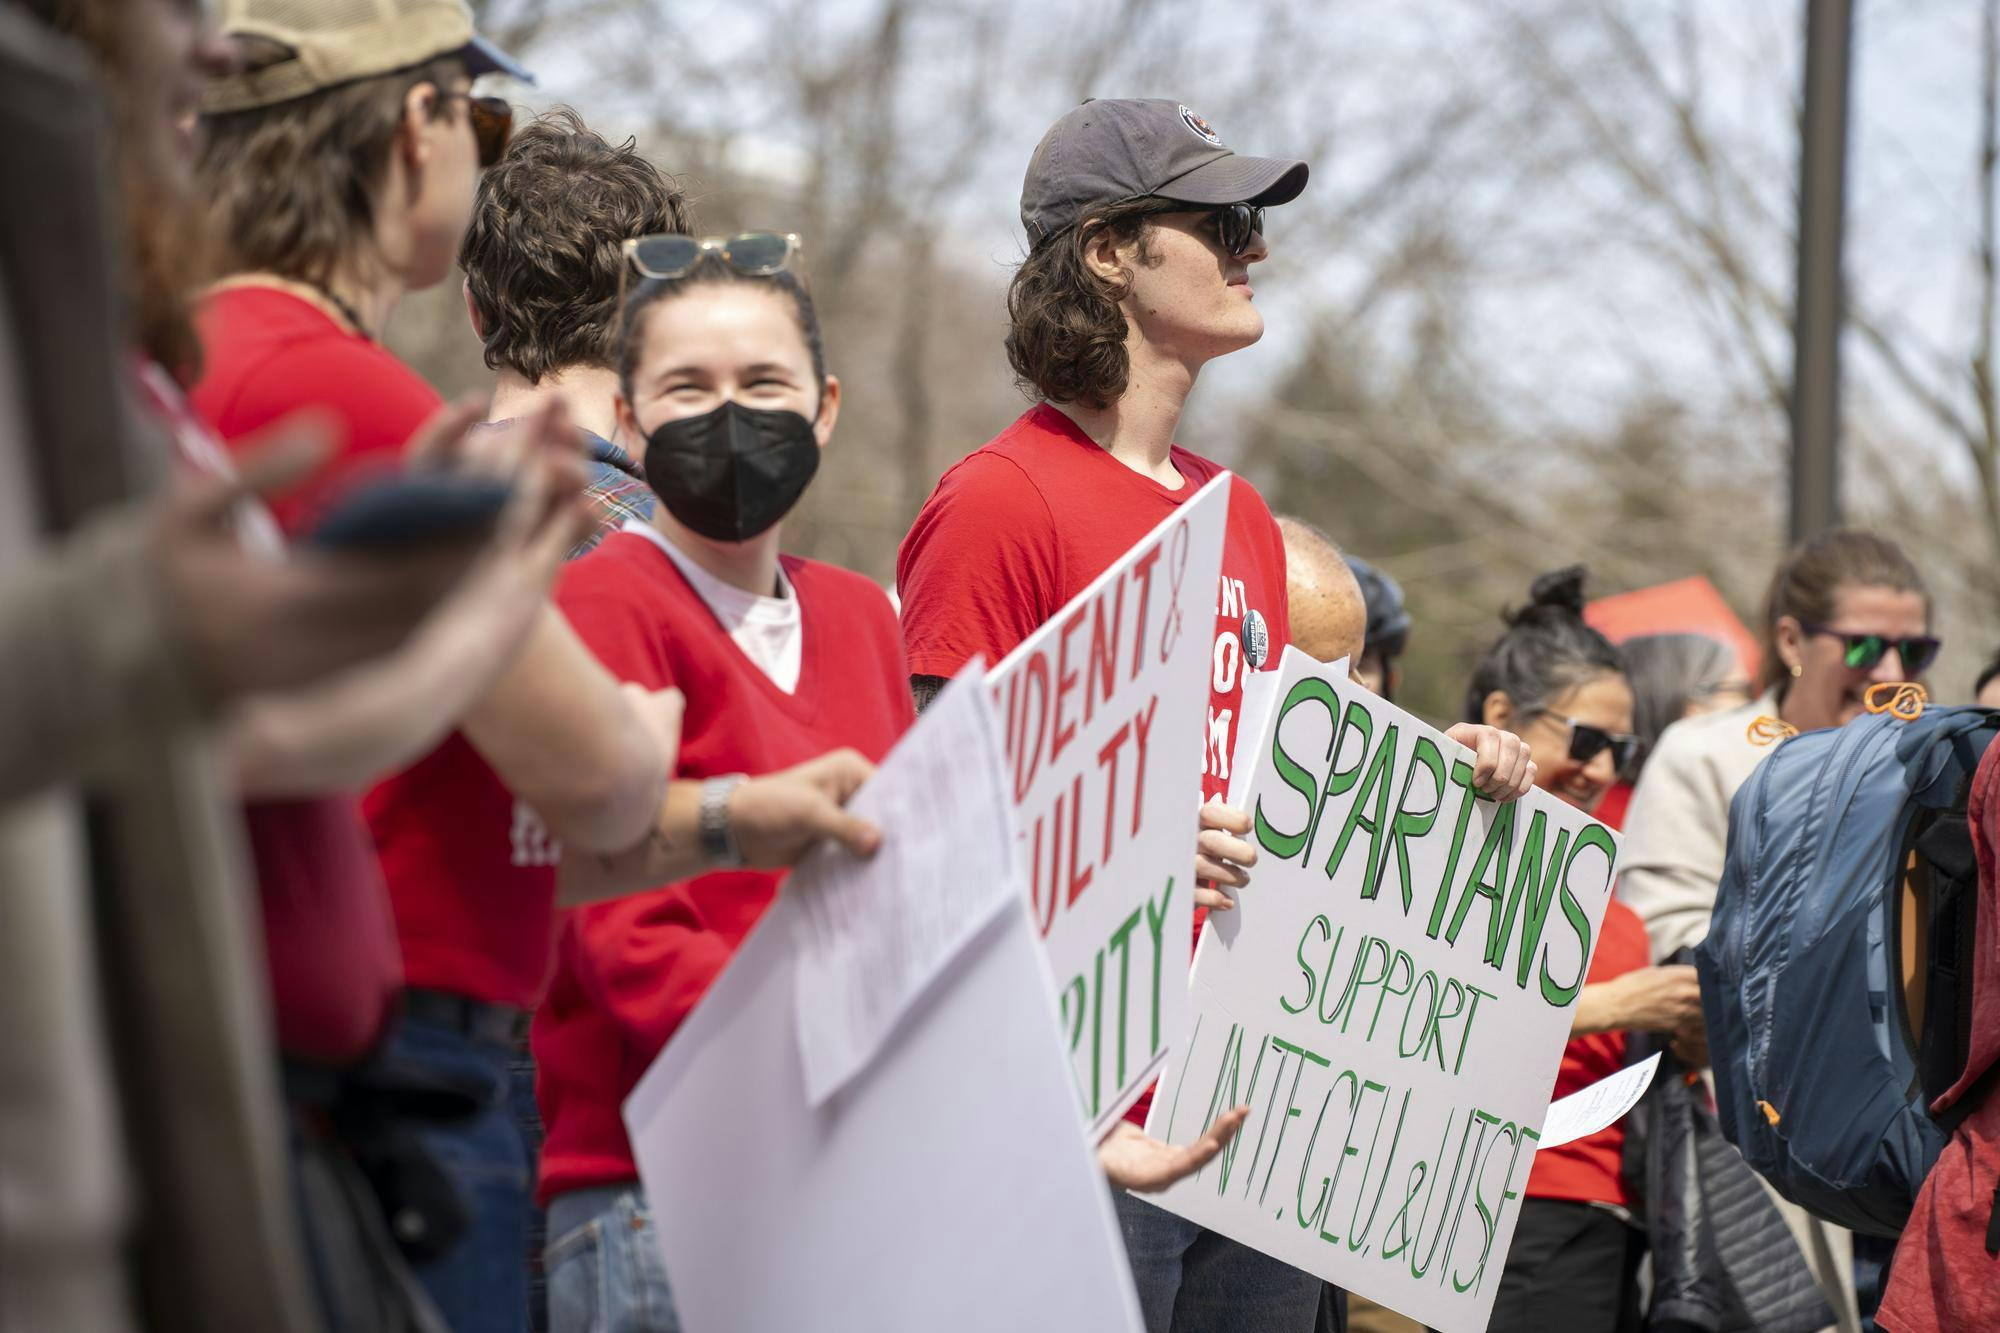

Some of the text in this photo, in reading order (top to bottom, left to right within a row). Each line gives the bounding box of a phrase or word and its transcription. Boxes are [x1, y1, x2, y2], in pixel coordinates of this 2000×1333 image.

[1159, 517, 1190, 665] &
[1214, 576, 1248, 619] NT
[1255, 676, 1617, 1007] SPARTANS
[1280, 914, 1498, 1075] SUPPORT
[1381, 1160, 1428, 1264] &
